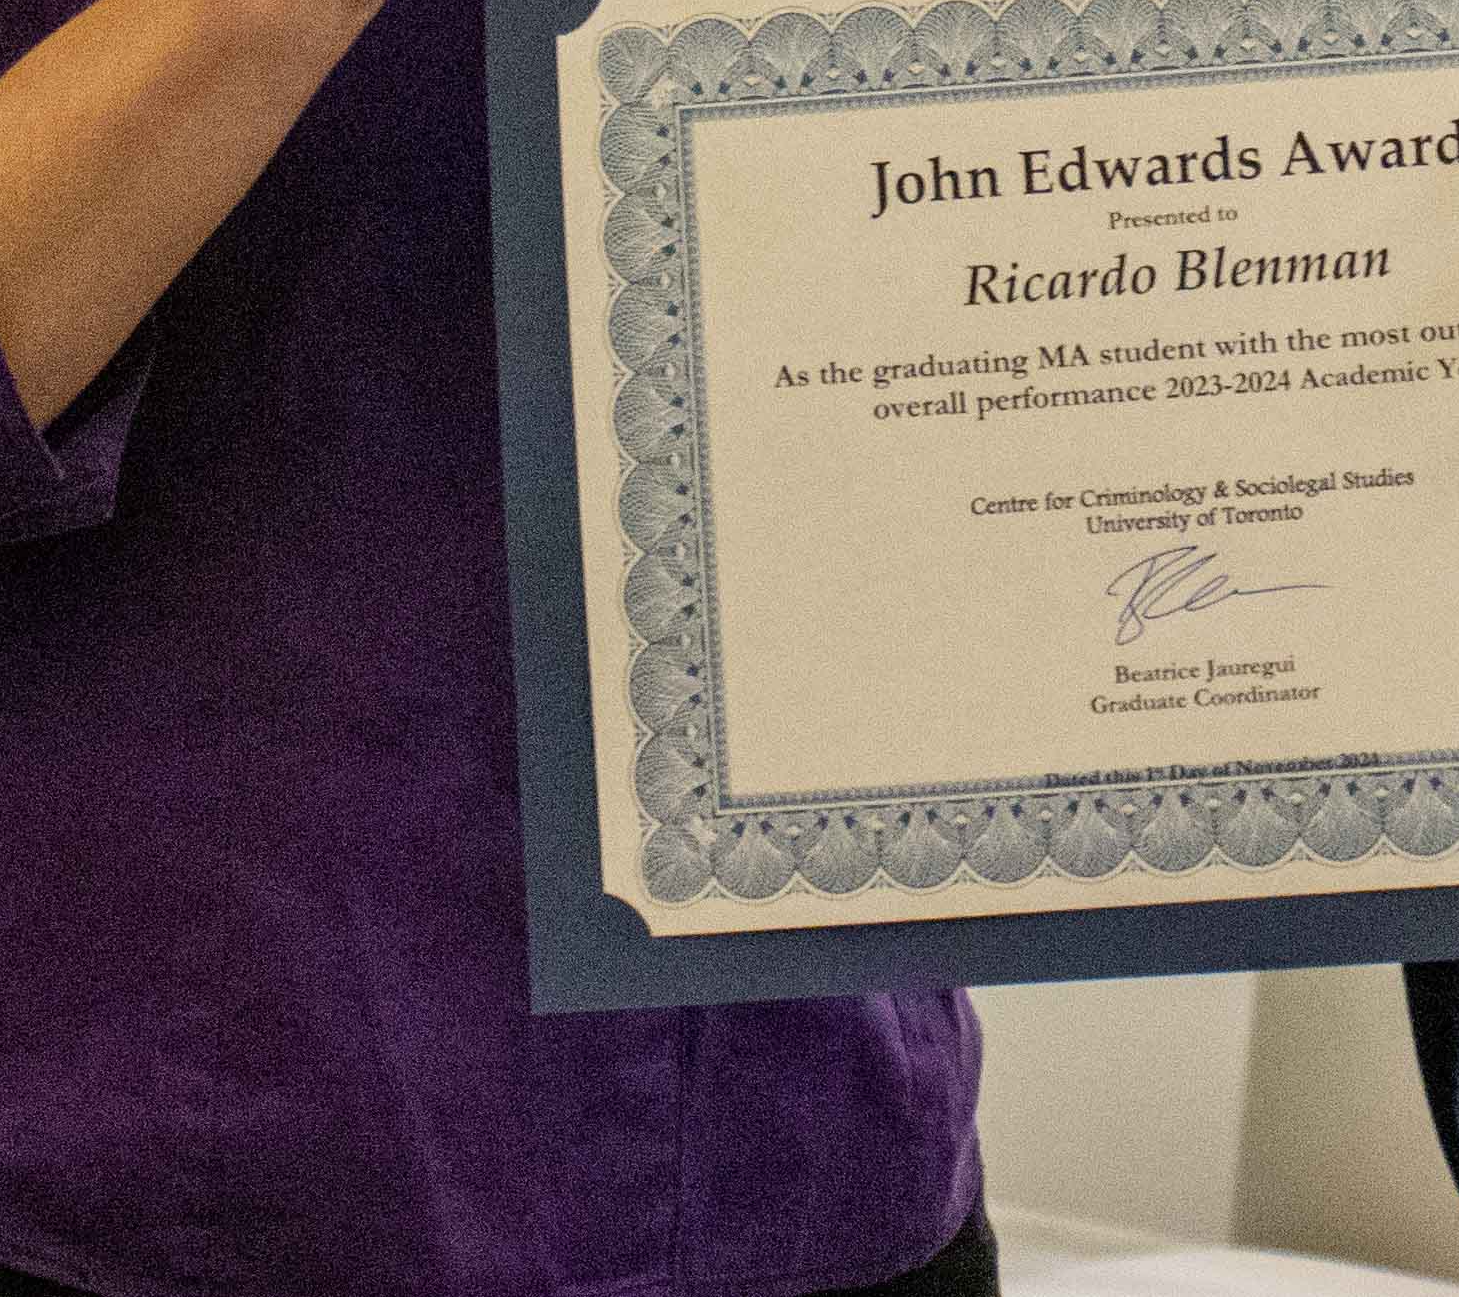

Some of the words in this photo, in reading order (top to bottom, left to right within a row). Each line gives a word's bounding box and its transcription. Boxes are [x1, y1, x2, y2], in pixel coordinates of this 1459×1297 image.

[871, 156, 1001, 219] John
[1019, 135, 1262, 195] Edwards
[1108, 205, 1211, 231] Presented
[1217, 208, 1239, 222] to
[963, 252, 1158, 307] Ricardo
[1174, 244, 1391, 292] Blenman
[774, 364, 811, 389] As
[819, 360, 863, 385] the
[872, 349, 1029, 390] graduating
[1037, 343, 1091, 370] MA
[1099, 337, 1207, 365] student
[1214, 330, 1278, 357] with
[1286, 327, 1331, 352] the
[1340, 326, 1411, 349] most
[872, 390, 968, 420] overall
[976, 384, 1157, 422] performance
[1165, 369, 1292, 400] 2023-2024
[1300, 360, 1430, 390] Academic
[969, 496, 1039, 517] Centre
[1044, 491, 1072, 512] for
[1079, 482, 1209, 509] Criminology
[1213, 480, 1229, 499] &
[1234, 471, 1338, 498] Sociolegal
[1342, 467, 1416, 491] Studies
[1085, 512, 1191, 535] University
[1195, 508, 1218, 527] of
[1221, 503, 1304, 525] Toronto
[1114, 664, 1201, 684] Beatrice
[1205, 659, 1297, 683] Jauregui
[1089, 695, 1186, 714] Graduate
[1192, 686, 1321, 707] Coordinator
